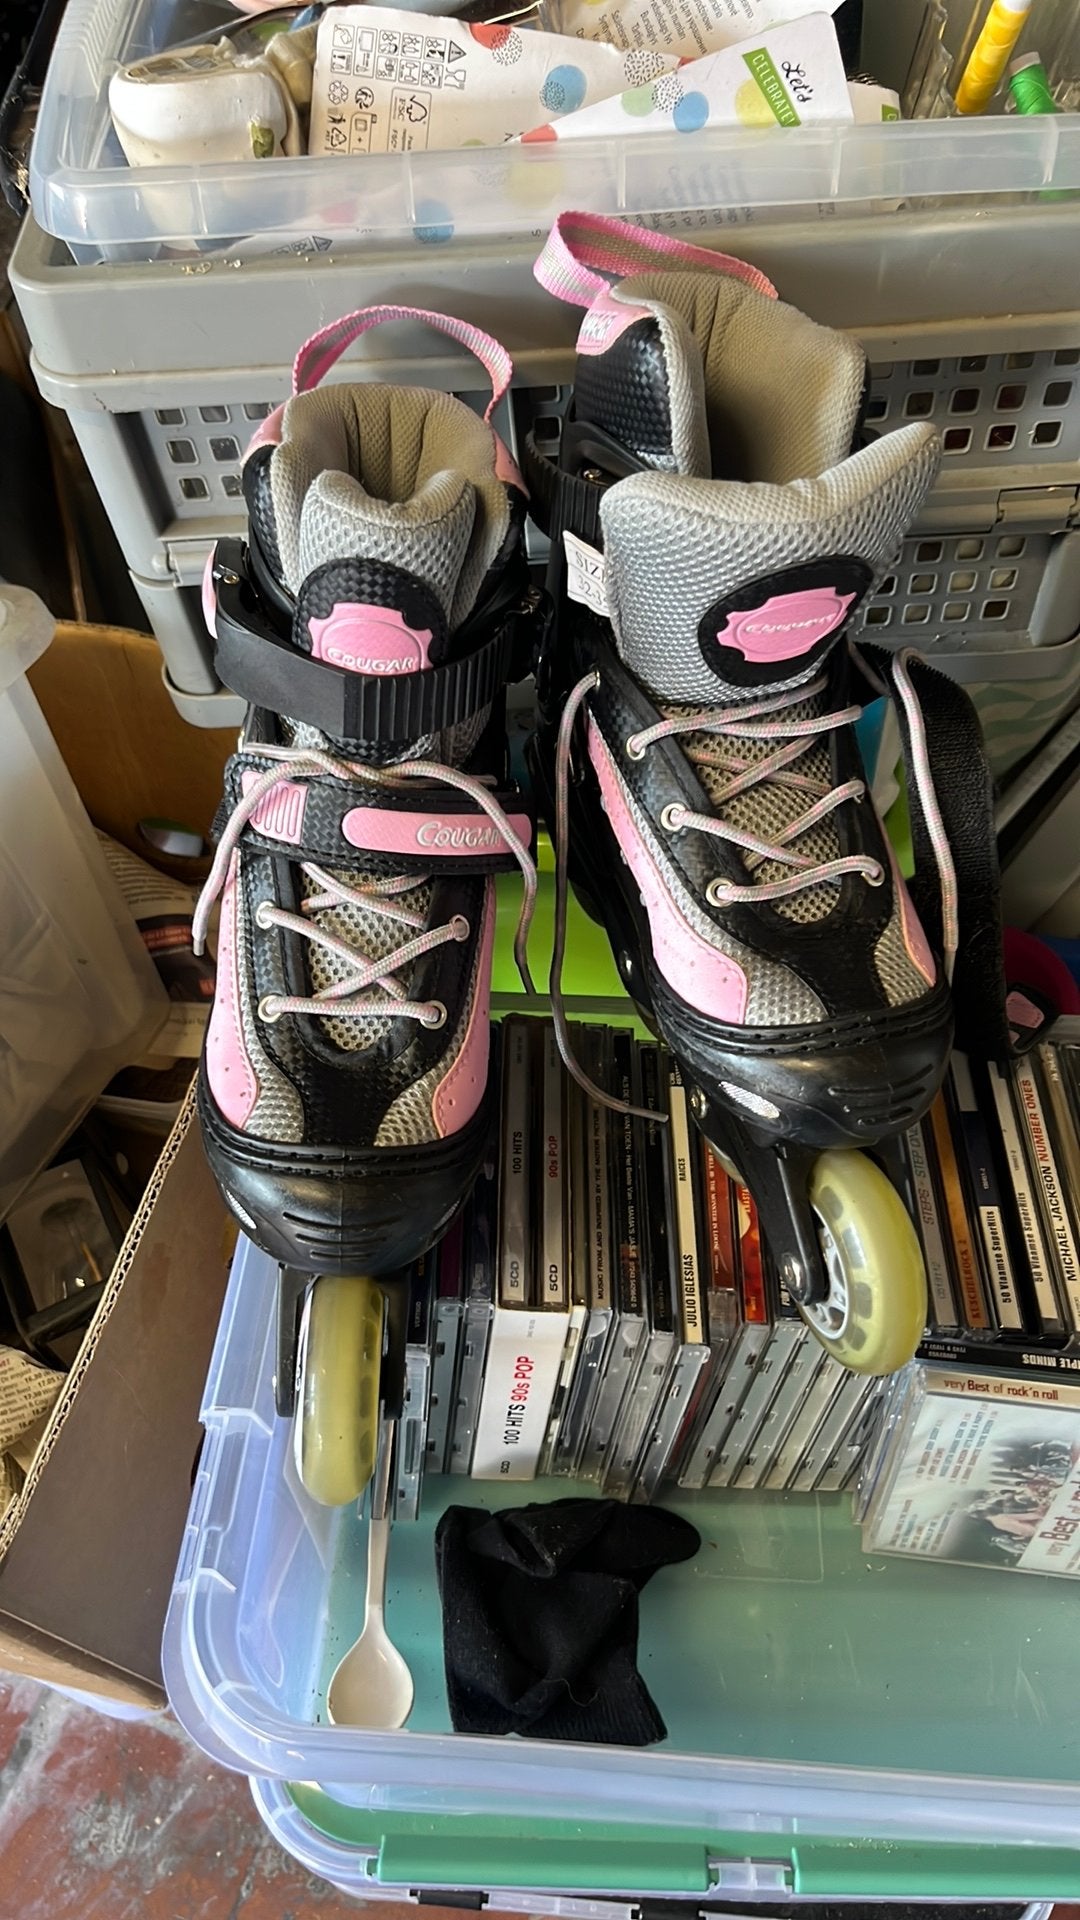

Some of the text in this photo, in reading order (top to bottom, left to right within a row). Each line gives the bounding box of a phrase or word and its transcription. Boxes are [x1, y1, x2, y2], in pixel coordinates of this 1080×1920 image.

[752, 54, 796, 126] CELEBRATE!
[781, 61, 815, 103] Let's
[326, 647, 418, 673] COUGAR
[512, 1131, 523, 1175] 100 HITS
[549, 1135, 559, 1179] 90s POP
[913, 1150, 925, 1177] STEP
[1021, 1079, 1078, 1282] MICHAEL JACKSON NUMBER ONES
[919, 1188, 933, 1225] STEPS
[1026, 1233, 1040, 1269] Vlaamse
[509, 1260, 520, 1289] 5CD
[549, 1263, 559, 1292] 5CD
[995, 1253, 1008, 1290] Vlaamse
[1034, 1271, 1043, 1282] 50
[681, 1254, 698, 1328] JULIO IGLESIAS
[1001, 1290, 1013, 1304] 50
[514, 1356, 535, 1380] POP
[1022, 1353, 1056, 1368] MINDS
[511, 1382, 530, 1402] 90s
[943, 1379, 966, 1393] very
[967, 1379, 990, 1393] Best
[993, 1381, 1004, 1394] of
[1041, 1389, 1059, 1401] roll
[505, 1404, 526, 1427] HITS
[503, 1429, 521, 1445] 100
[500, 1460, 511, 1474] 5CD
[1039, 1515, 1080, 1542] Best
